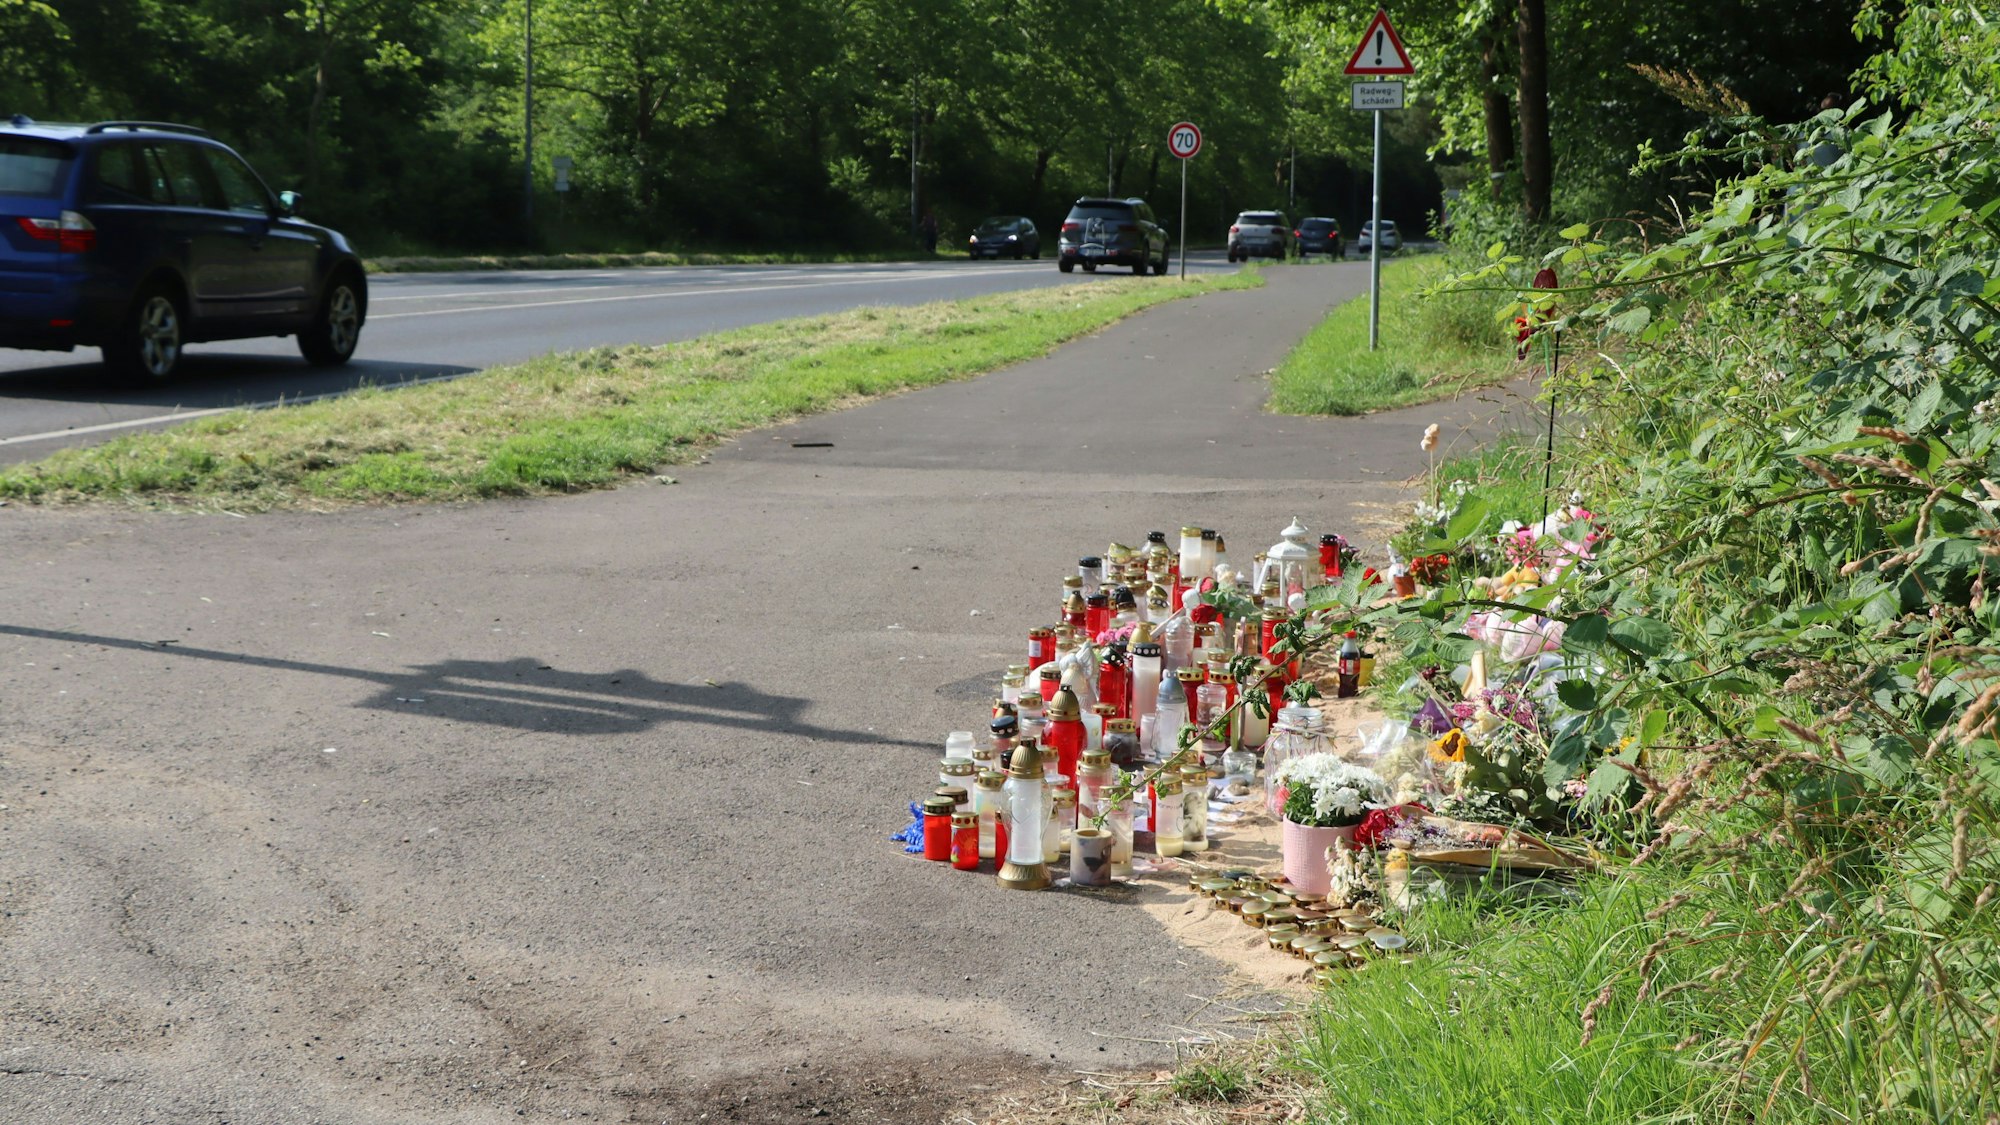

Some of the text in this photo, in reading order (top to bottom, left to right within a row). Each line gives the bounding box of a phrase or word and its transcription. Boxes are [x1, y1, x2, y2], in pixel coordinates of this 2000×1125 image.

[1360, 87, 1396, 96] Radweg-
[1361, 96, 1395, 104] schäden
[1176, 133, 1194, 148] 70
